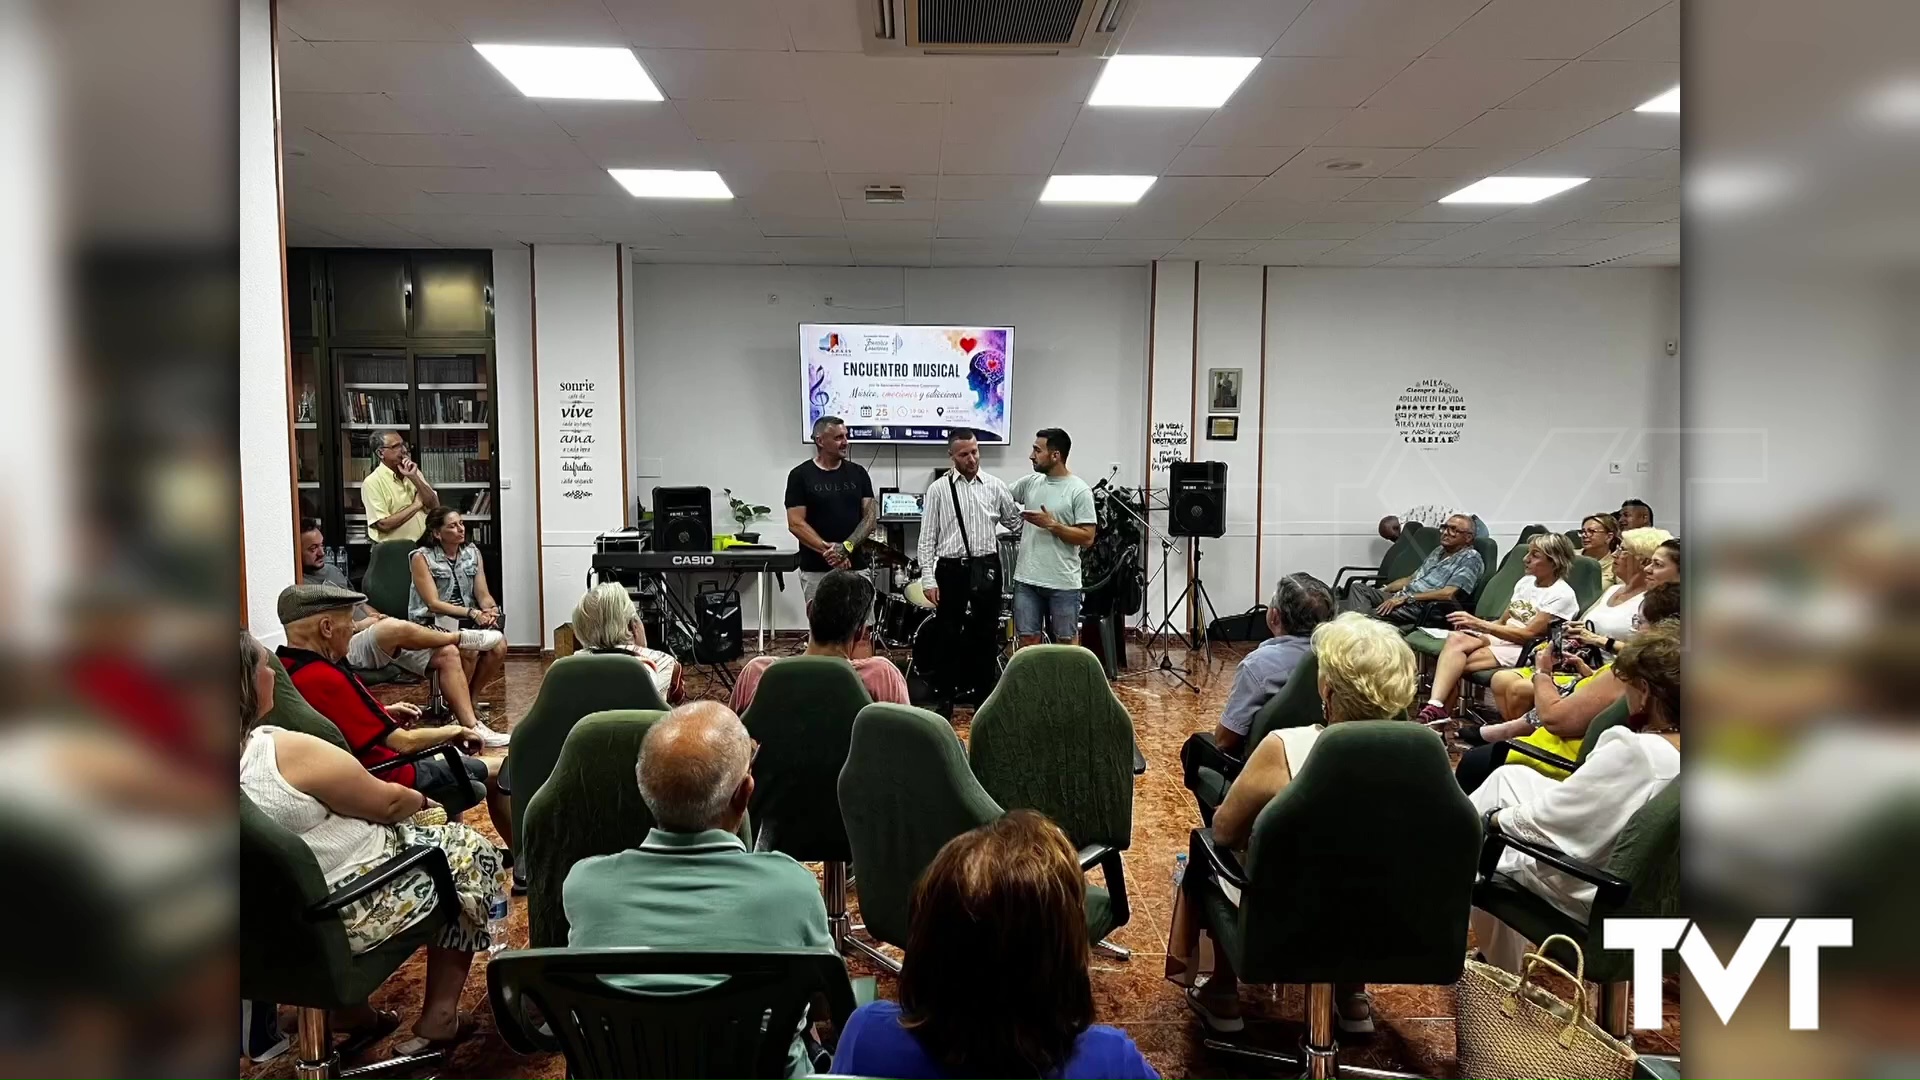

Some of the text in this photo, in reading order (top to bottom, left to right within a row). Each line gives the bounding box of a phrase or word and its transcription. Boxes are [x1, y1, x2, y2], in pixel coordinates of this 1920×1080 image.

[843, 362, 961, 378] ENCUENTRO MUSICAL
[881, 390, 918, 398] emociones
[919, 391, 925, 401] y
[925, 388, 962, 398] adicciones
[561, 404, 594, 418] vive
[875, 408, 888, 417] 25
[560, 435, 595, 443] ama
[562, 461, 593, 477] disfruta
[814, 482, 857, 492] GUESS
[672, 556, 715, 565] CASIO
